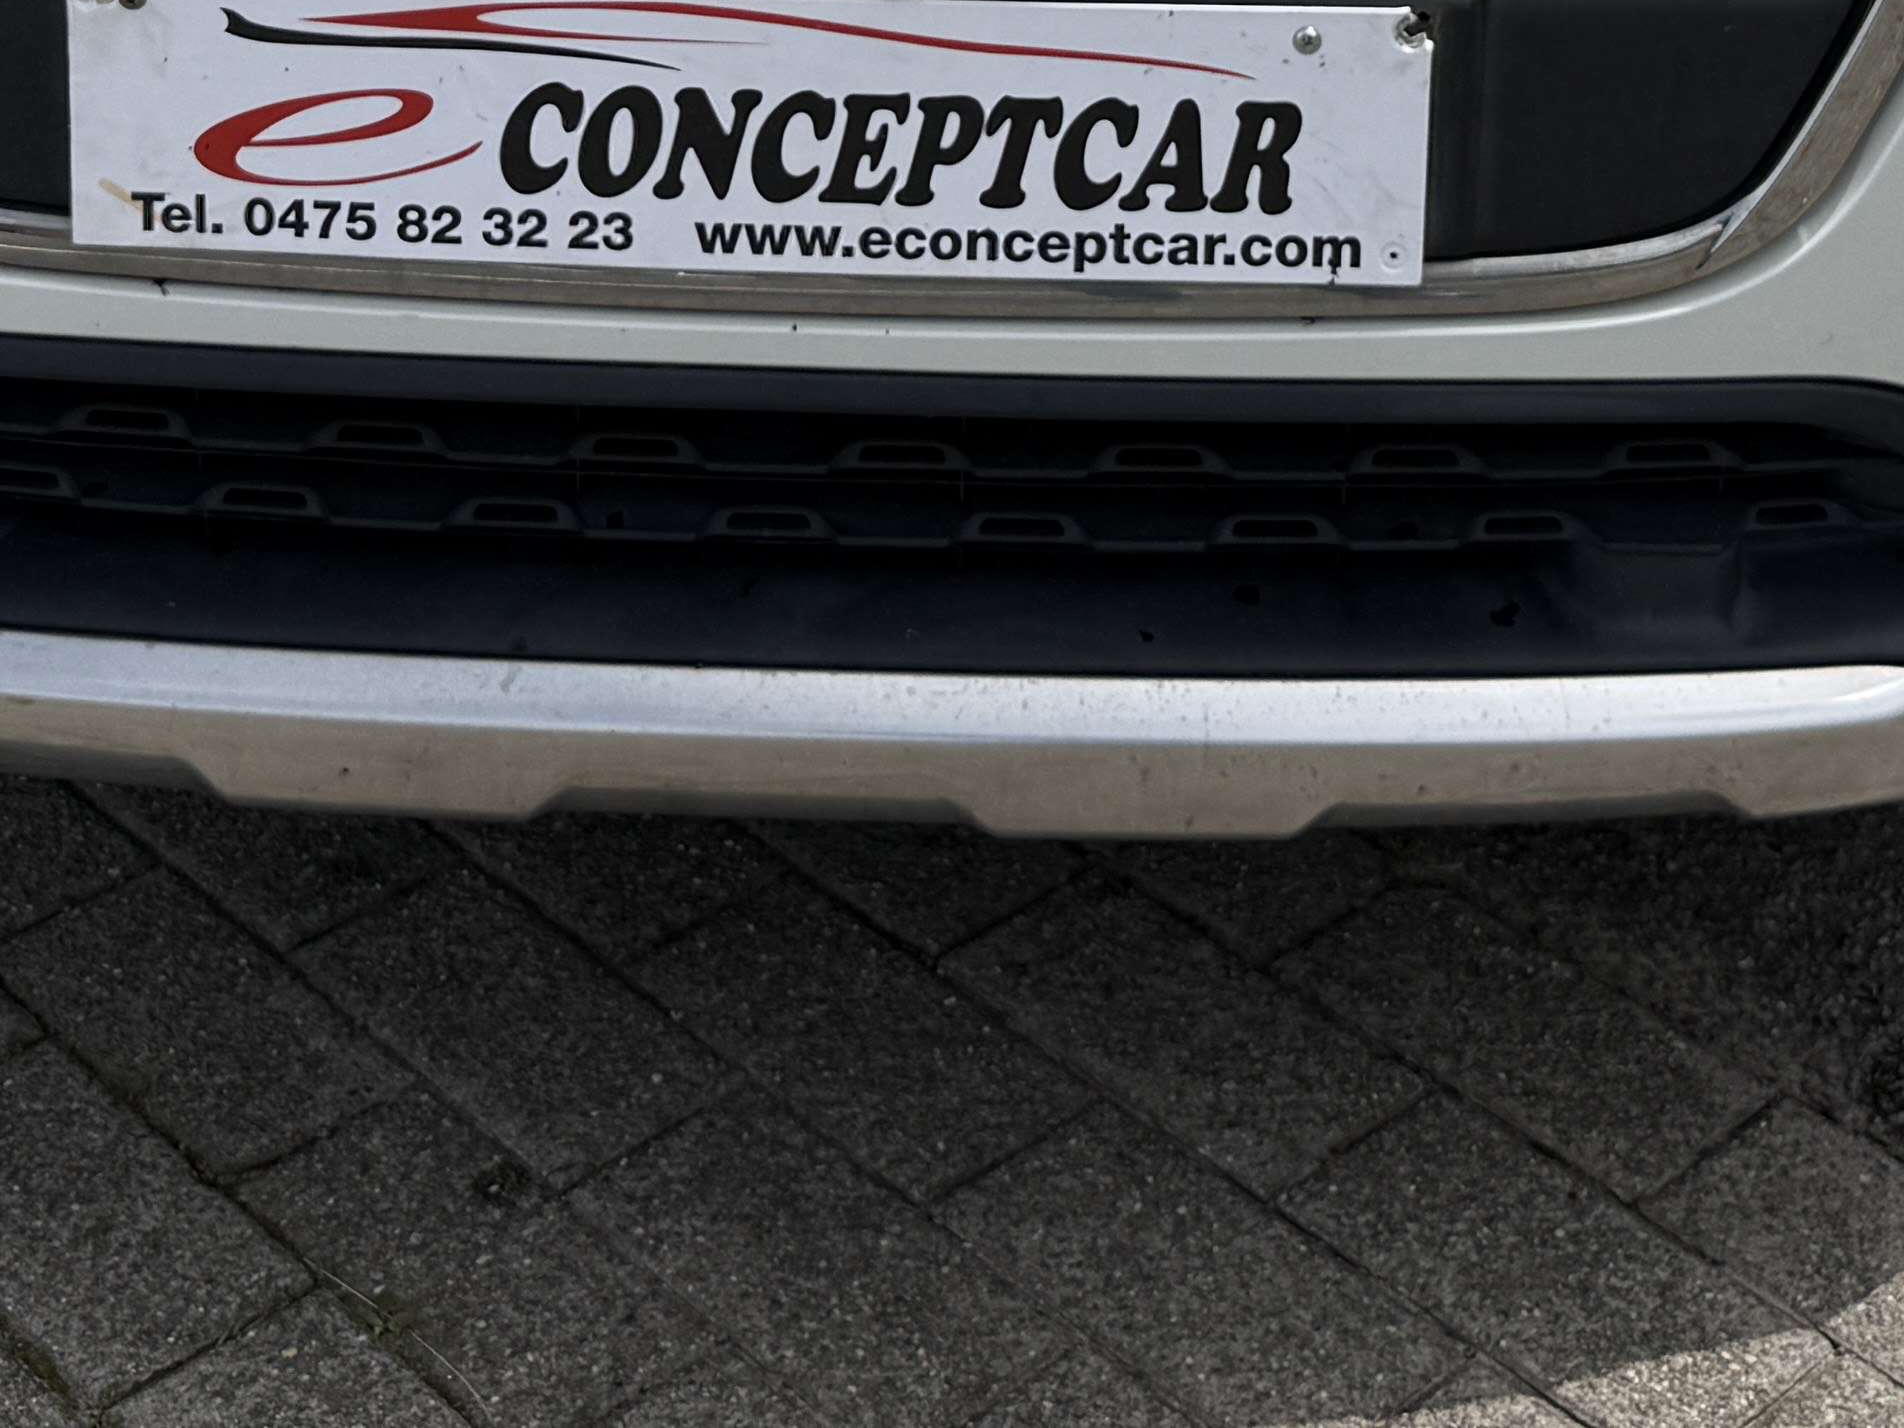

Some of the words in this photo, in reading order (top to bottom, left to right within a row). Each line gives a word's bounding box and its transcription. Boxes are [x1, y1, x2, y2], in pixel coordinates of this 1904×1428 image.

[498, 82, 1303, 214] CONCEPTCAR
[132, 188, 224, 234] Tel.
[242, 193, 376, 240] 0475
[396, 201, 462, 245] 82
[480, 205, 550, 248] 32
[564, 209, 634, 251] 23
[695, 216, 1363, 277] www.econceptcar.com
